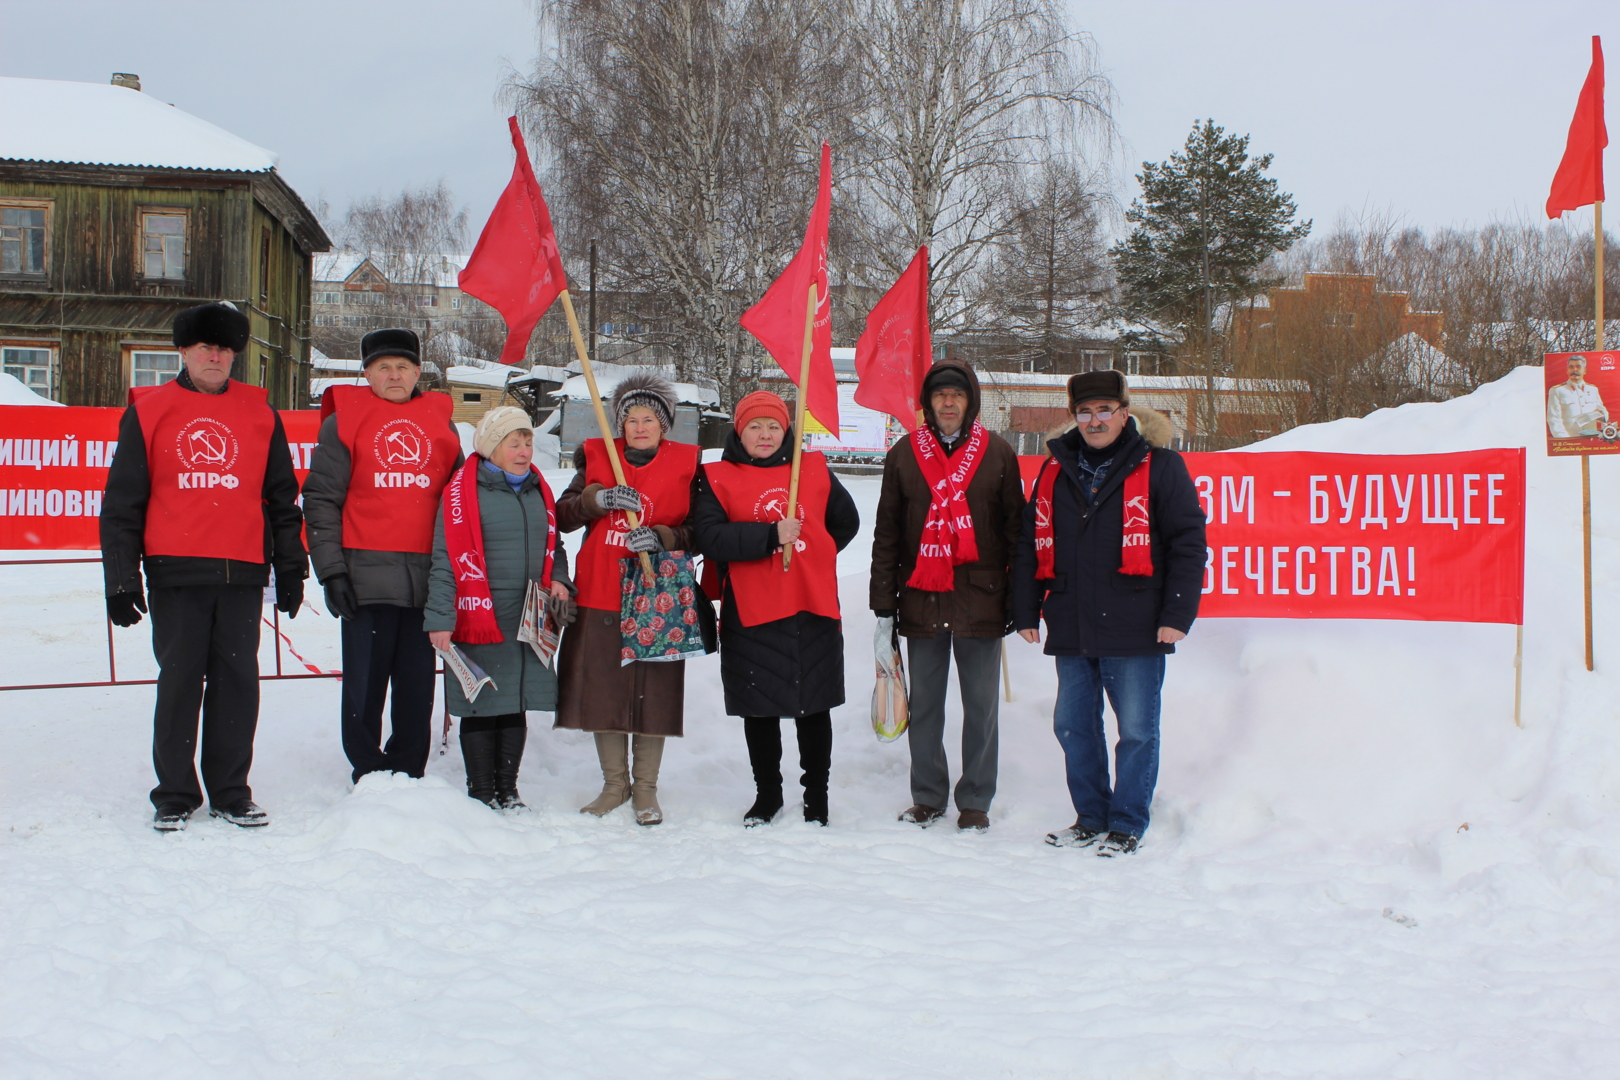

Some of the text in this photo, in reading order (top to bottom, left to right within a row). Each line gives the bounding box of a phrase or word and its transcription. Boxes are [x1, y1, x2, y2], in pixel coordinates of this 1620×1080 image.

[288, 442, 320, 469] АТ
[178, 472, 240, 490] КПРФ
[374, 472, 430, 489] КПРФ
[0, 488, 106, 517] ИНОВН
[1195, 475, 1255, 525] ЗМ
[1309, 473, 1505, 531] БУДУЩЕЕ
[605, 529, 628, 548] КП
[458, 596, 493, 611] КПРФ
